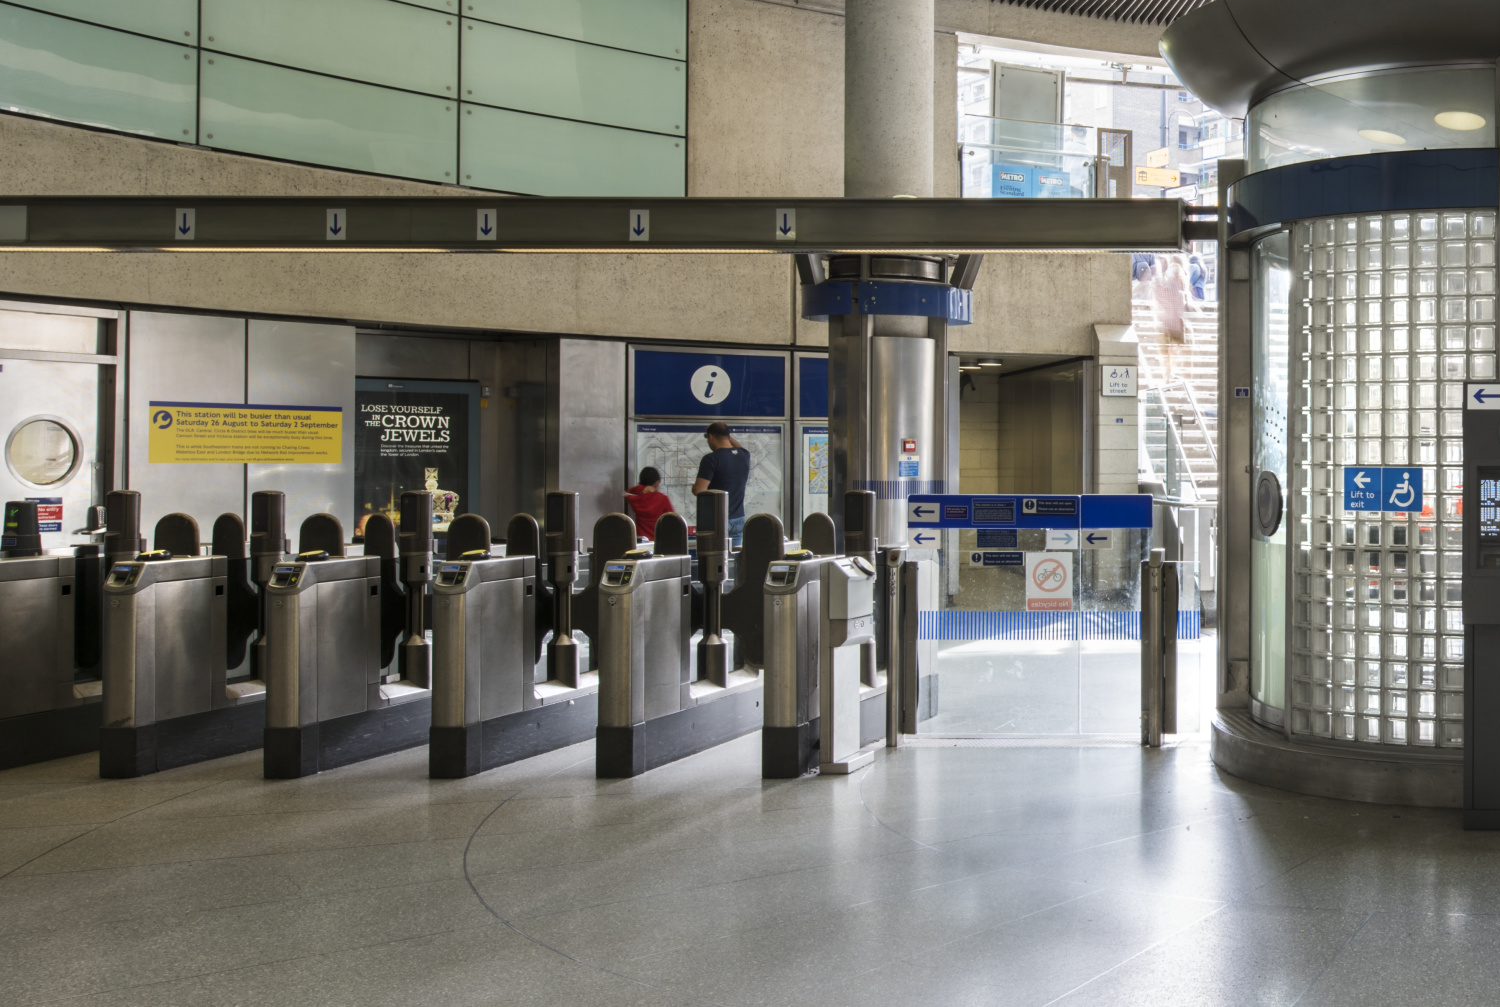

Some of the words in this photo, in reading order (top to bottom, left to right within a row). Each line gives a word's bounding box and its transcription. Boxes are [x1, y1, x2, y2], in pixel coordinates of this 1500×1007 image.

[361, 404, 388, 412] LOSE
[390, 405, 443, 414] YOURSELF
[176, 419, 208, 427] Saturday
[381, 415, 450, 429] CROWN
[380, 429, 450, 442] JEWELS
[1350, 500, 1364, 508] exit
